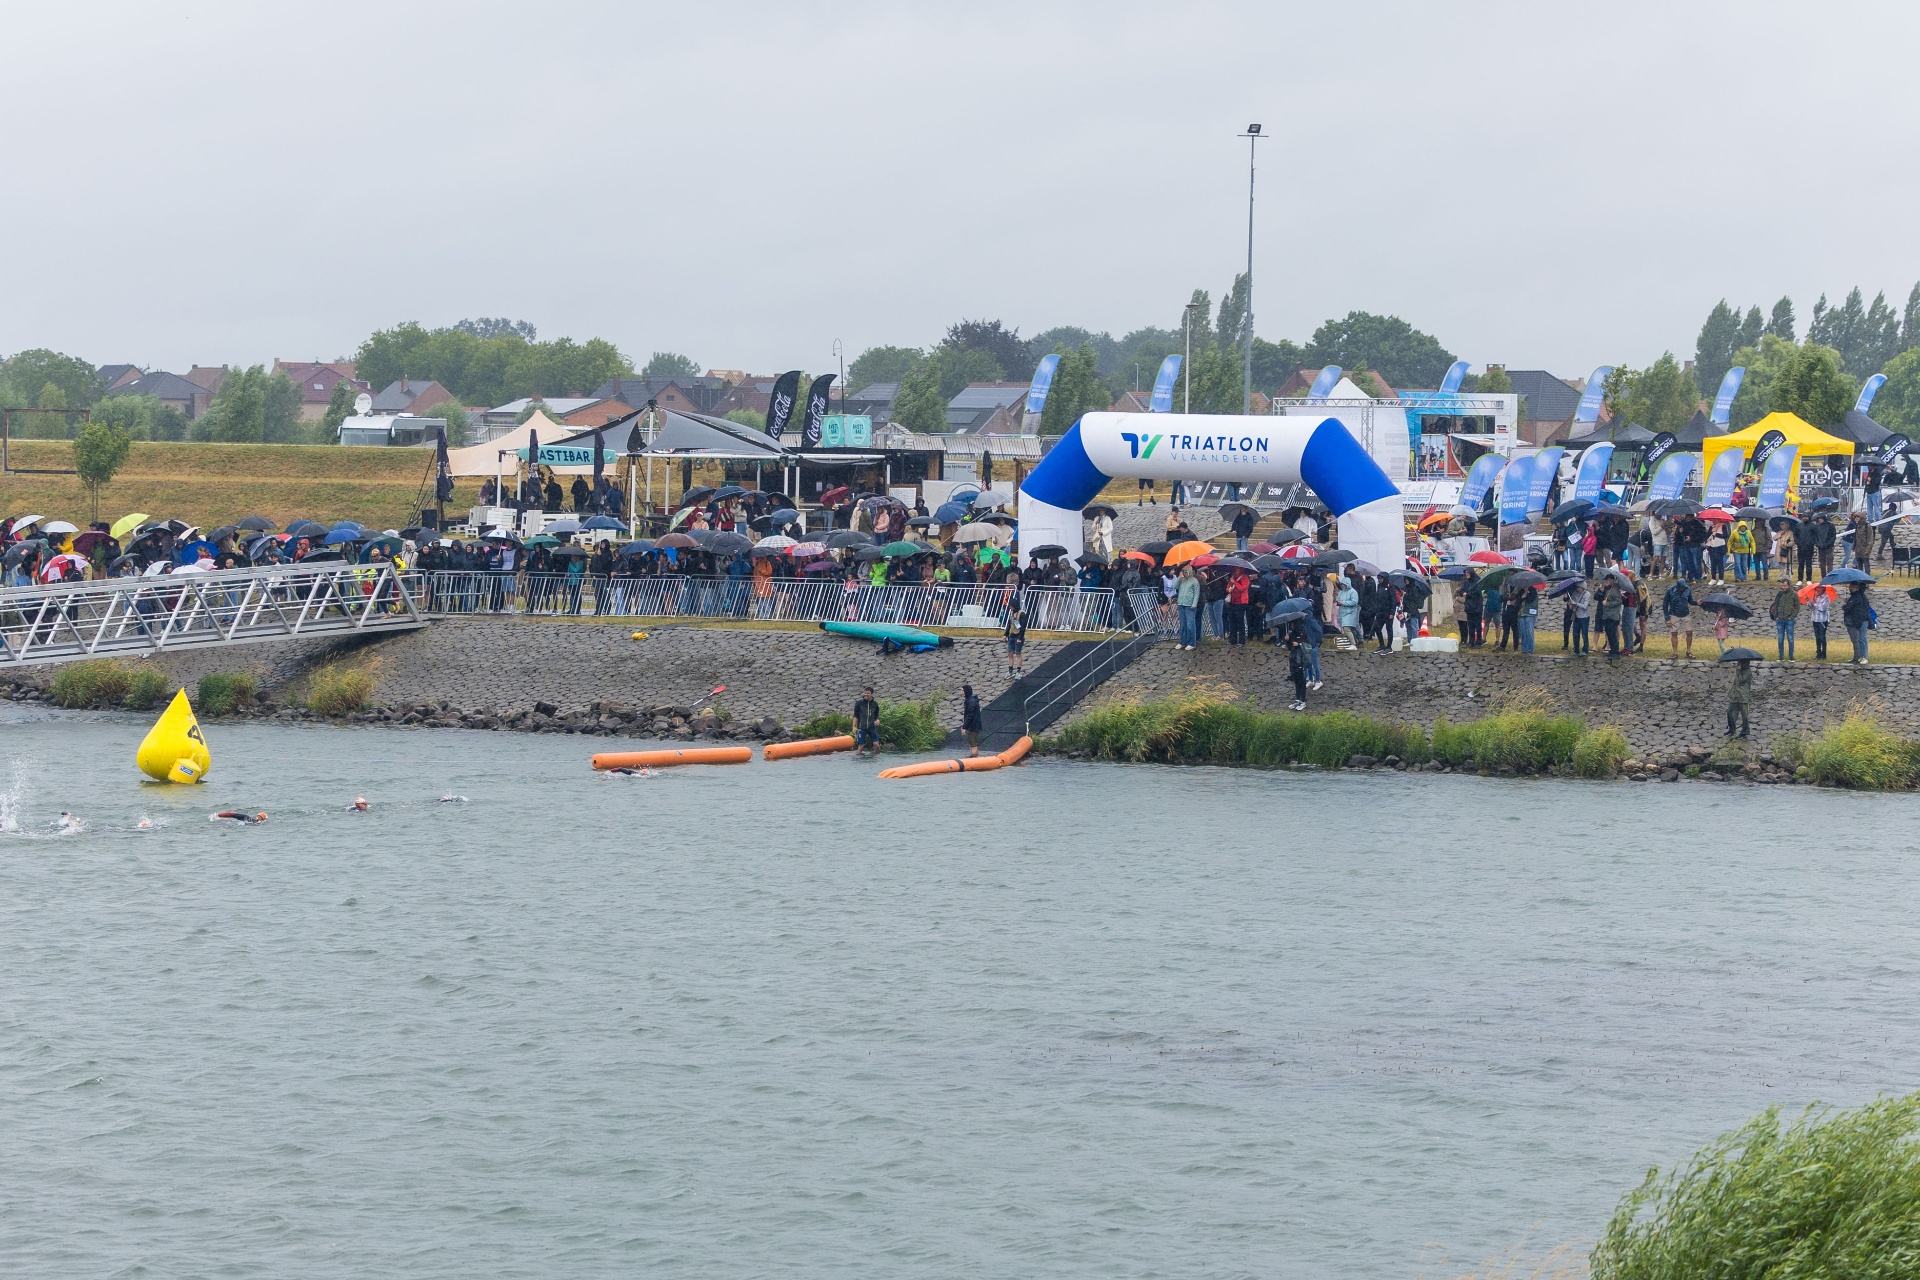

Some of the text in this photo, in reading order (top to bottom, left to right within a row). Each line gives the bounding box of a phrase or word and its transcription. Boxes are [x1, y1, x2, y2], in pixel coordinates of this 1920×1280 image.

[1170, 435, 1269, 452] TRIATLON
[1648, 438, 1675, 462] WORK-OUT
[1758, 436, 1784, 462] WORK-OUT
[1171, 453, 1269, 464] VLAANDEREN
[1576, 490, 1599, 498] GRIND
[1502, 501, 1527, 509] GRIND
